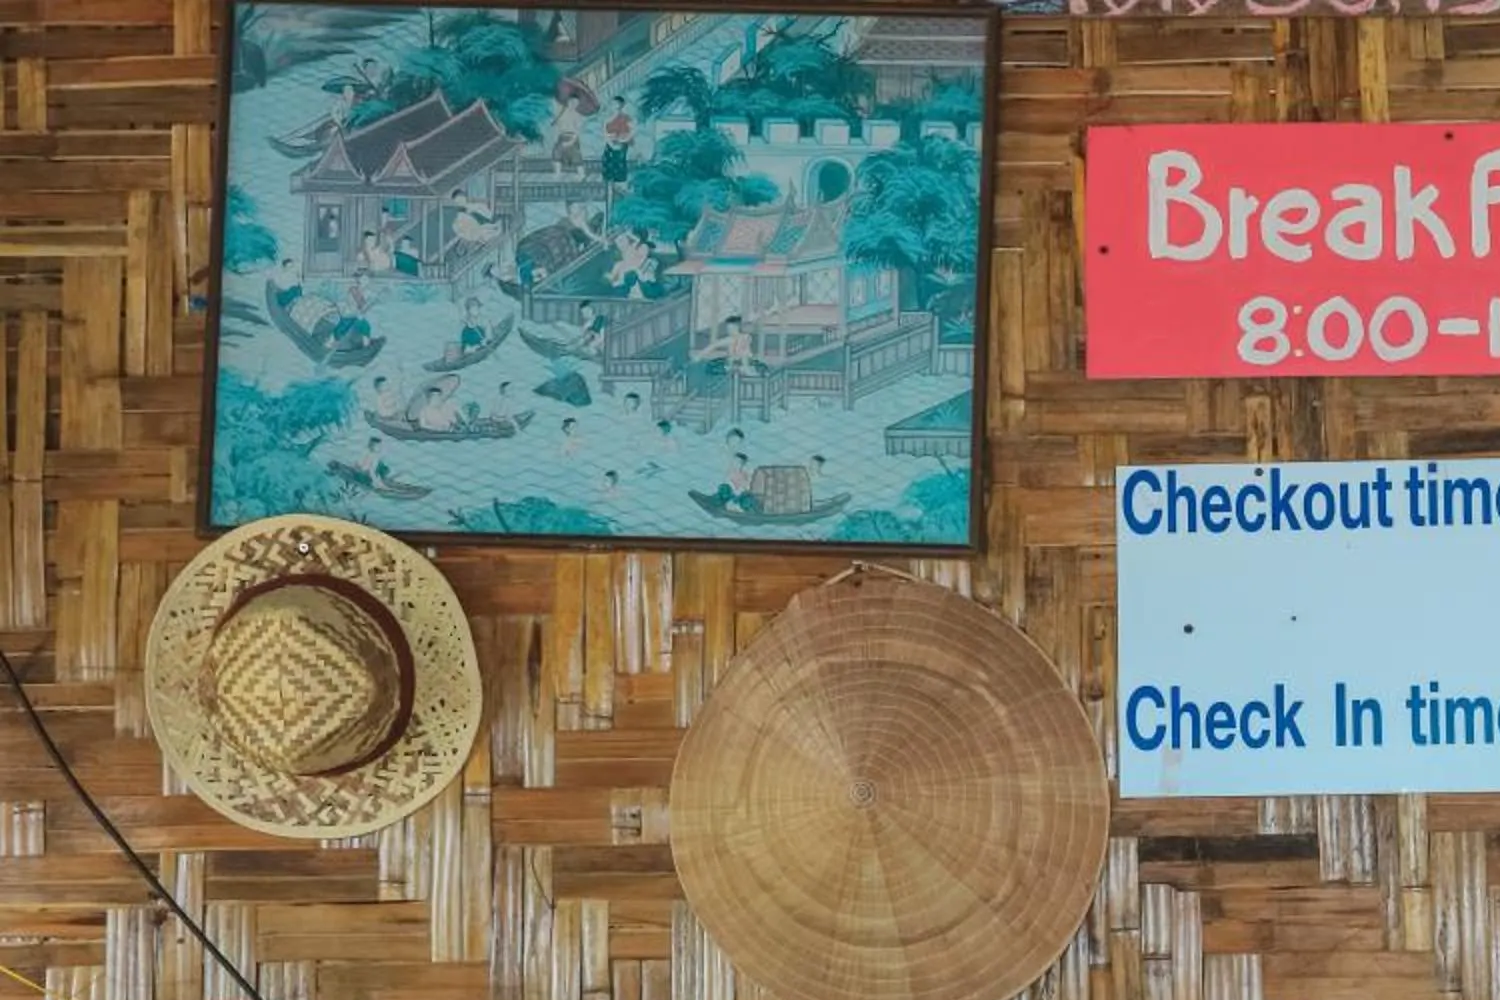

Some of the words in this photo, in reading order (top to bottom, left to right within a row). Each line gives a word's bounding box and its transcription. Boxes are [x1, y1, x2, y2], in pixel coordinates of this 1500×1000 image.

[1122, 467, 1394, 535] Checkout
[1125, 683, 1306, 751] Check
[1335, 682, 1384, 748] In
